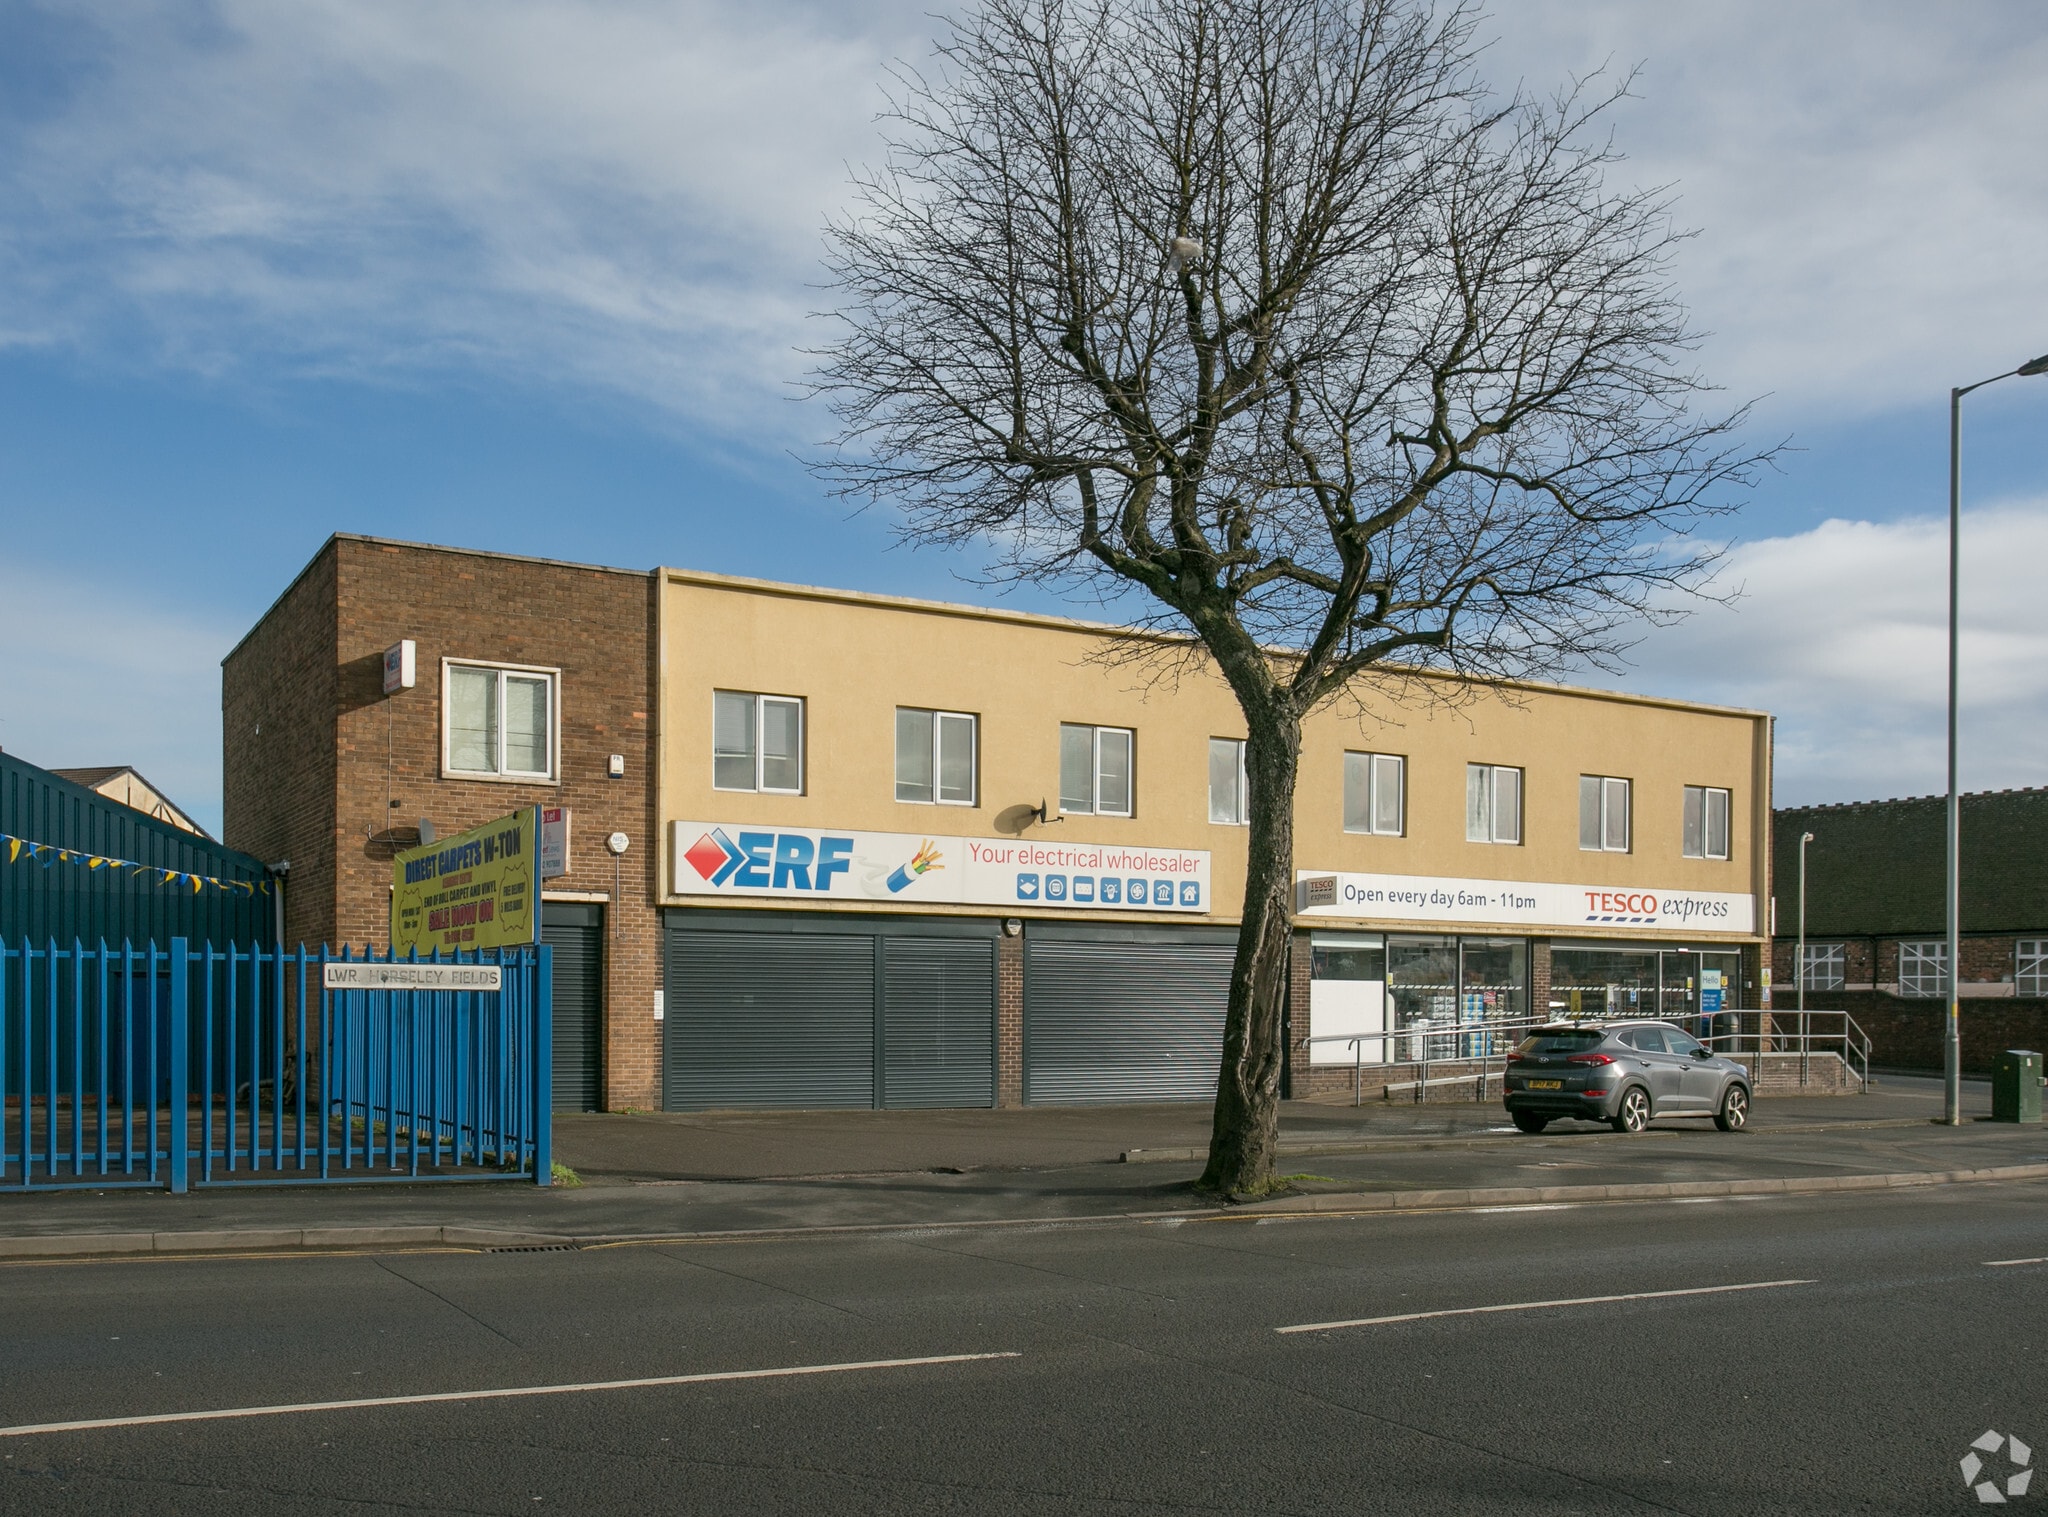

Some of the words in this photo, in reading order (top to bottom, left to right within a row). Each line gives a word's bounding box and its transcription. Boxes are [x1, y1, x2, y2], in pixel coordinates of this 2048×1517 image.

[546, 811, 556, 822] Let
[405, 854, 437, 884] DIRECT
[440, 840, 481, 876] CARPETS
[484, 826, 520, 864] W-TON
[734, 831, 854, 891] ERF
[970, 842, 1014, 864] Your
[1018, 845, 1102, 868] electrical
[1107, 850, 1200, 873] wholesaler
[450, 887, 469, 902] CARPET
[470, 884, 480, 898] AND
[482, 880, 496, 895] VINYL
[1310, 880, 1334, 889] TESCO
[1310, 892, 1333, 902] express
[1344, 884, 1384, 904] Open
[1388, 890, 1427, 908] every
[1430, 889, 1454, 908] day
[1458, 890, 1487, 906] 6am
[1500, 892, 1536, 909] 11pm
[1585, 892, 1658, 914] TESCO
[1662, 897, 1728, 922] express
[428, 906, 450, 932] SALE
[451, 901, 478, 927] NOW
[478, 898, 494, 923] ON
[328, 969, 360, 983] LWR.
[369, 970, 443, 984] HORSELEY
[451, 971, 498, 984] FIELDS
[1702, 976, 1719, 984] Hello
